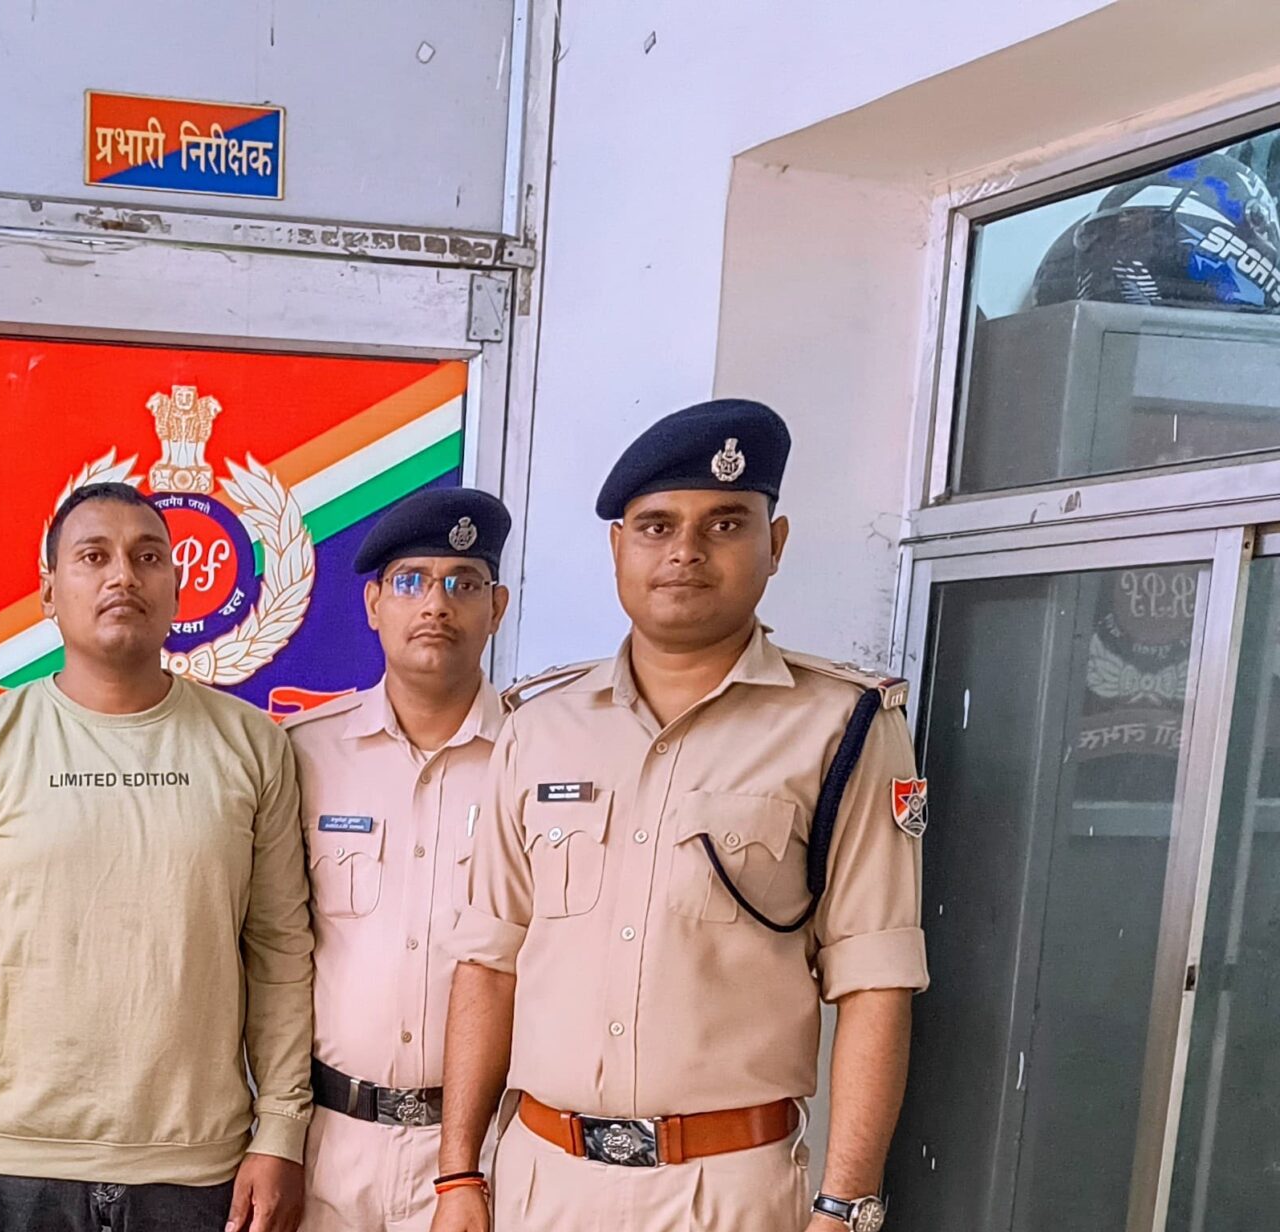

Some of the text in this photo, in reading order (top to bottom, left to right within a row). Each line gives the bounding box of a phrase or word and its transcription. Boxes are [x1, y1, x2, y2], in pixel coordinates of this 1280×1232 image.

[95, 116, 273, 177] प्रभारी निरीक्षक
[1199, 225, 1280, 304] SPORT
[154, 494, 184, 509] त्यमेव
[49, 771, 190, 788] LIMITED EDITION
